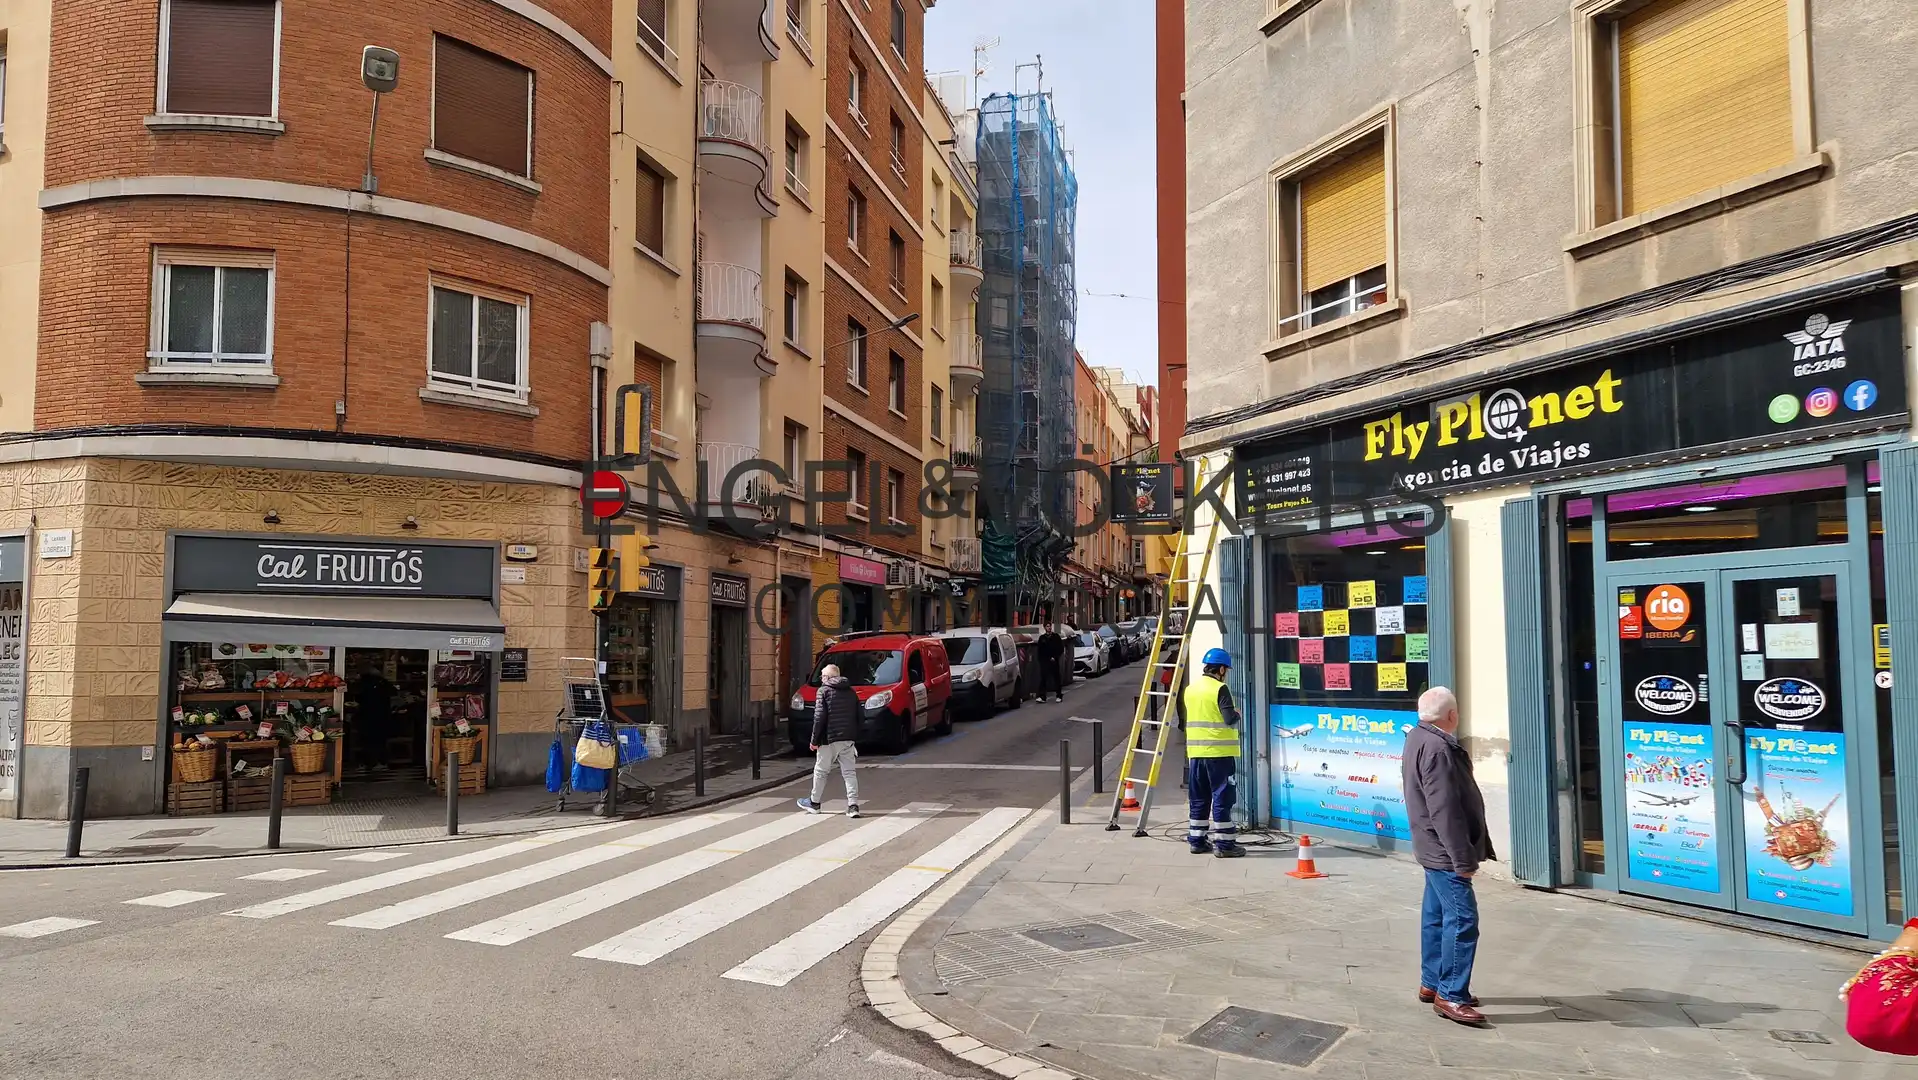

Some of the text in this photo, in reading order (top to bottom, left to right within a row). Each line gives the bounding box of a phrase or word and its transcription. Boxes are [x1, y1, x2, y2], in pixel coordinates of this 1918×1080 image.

[1793, 336, 1845, 361] IATA
[1793, 356, 1847, 377] GC:2346
[1363, 411, 1430, 463] Fly
[1390, 441, 1591, 491] Agencia de Viajes
[1271, 473, 1283, 483] 631
[1284, 470, 1297, 480] 997
[1297, 468, 1311, 478] 423
[41, 545, 70, 554] LLOBREGAT
[257, 553, 307, 579] Cal
[1650, 590, 1684, 614] ria
[1645, 631, 1680, 639] IBERIA
[1639, 689, 1692, 701] WELCOME
[1758, 693, 1821, 706] WELCOME
[1643, 698, 1686, 712] BIENVENIDOS
[1764, 703, 1814, 717] BIENVENIDOS
[1317, 713, 1340, 734] Fly
[1630, 729, 1652, 744] Fly
[1750, 736, 1776, 753] Fly
[1348, 775, 1369, 783] IBERIA
[1633, 823, 1658, 831] IBERIA
